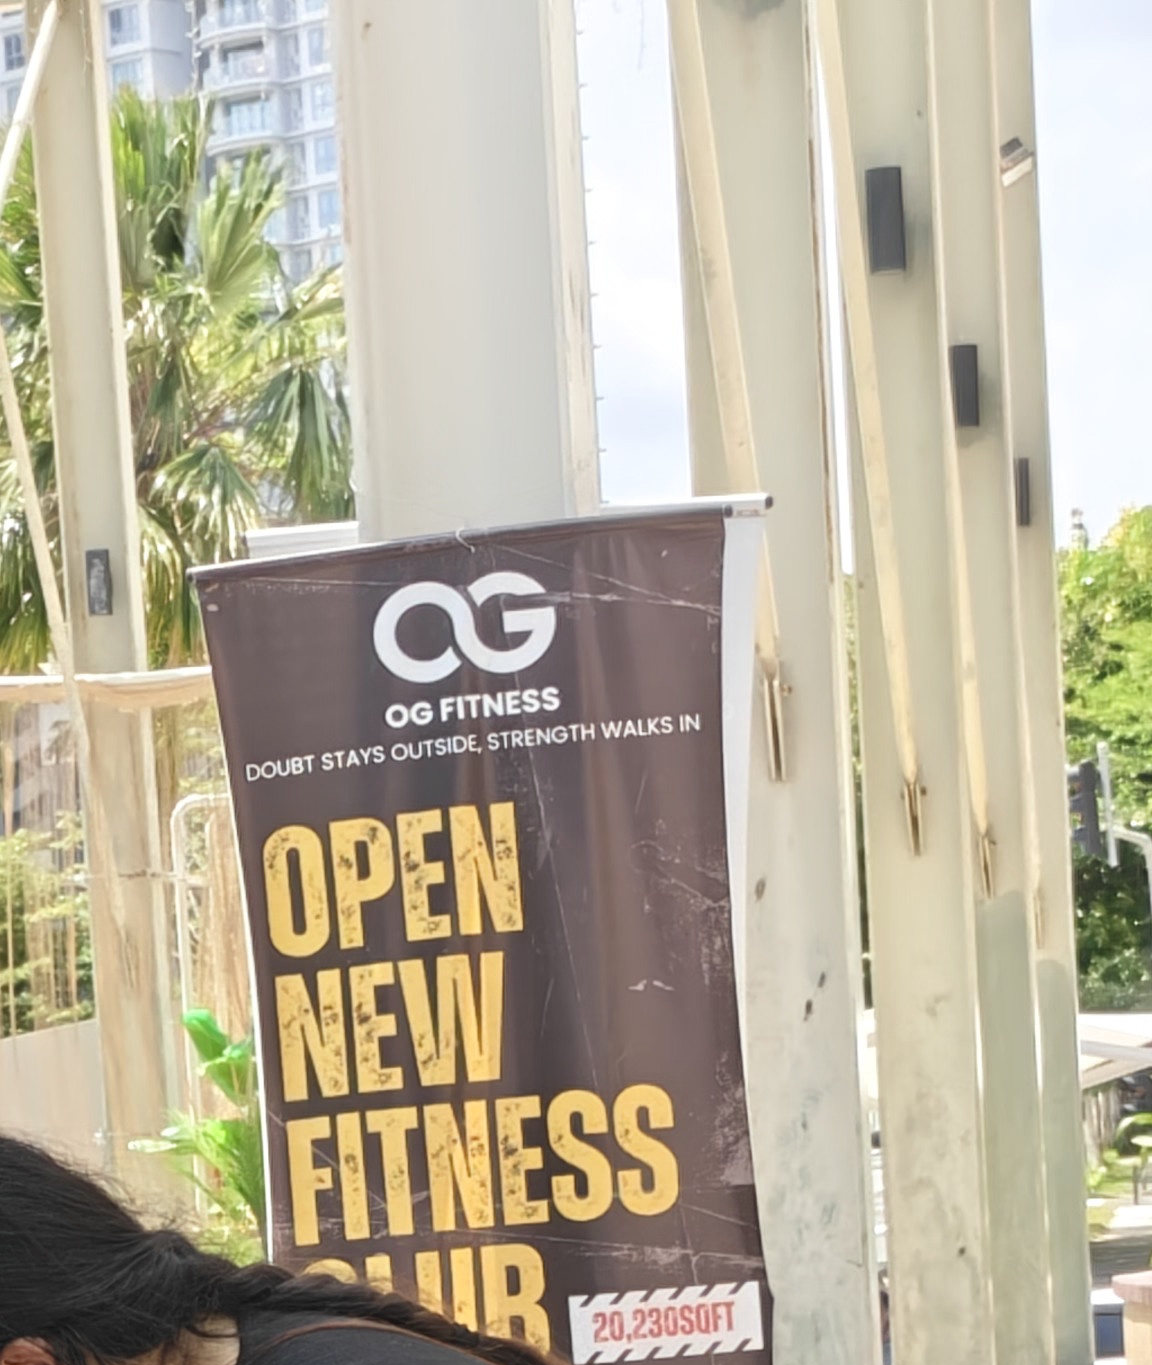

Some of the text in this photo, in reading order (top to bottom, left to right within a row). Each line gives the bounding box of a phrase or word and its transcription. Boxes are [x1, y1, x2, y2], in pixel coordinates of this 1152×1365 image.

[245, 713, 702, 782] DOUBT STAYS OUTSIDE, STRENGTH WALKS IN
[384, 687, 561, 728] OG FITNESS
[262, 801, 525, 957] OPEN
[275, 951, 505, 1102] NEW
[286, 1083, 679, 1245] FITNESS
[303, 1243, 551, 1355] UB
[592, 1300, 736, 1343] 20,230SQFT
